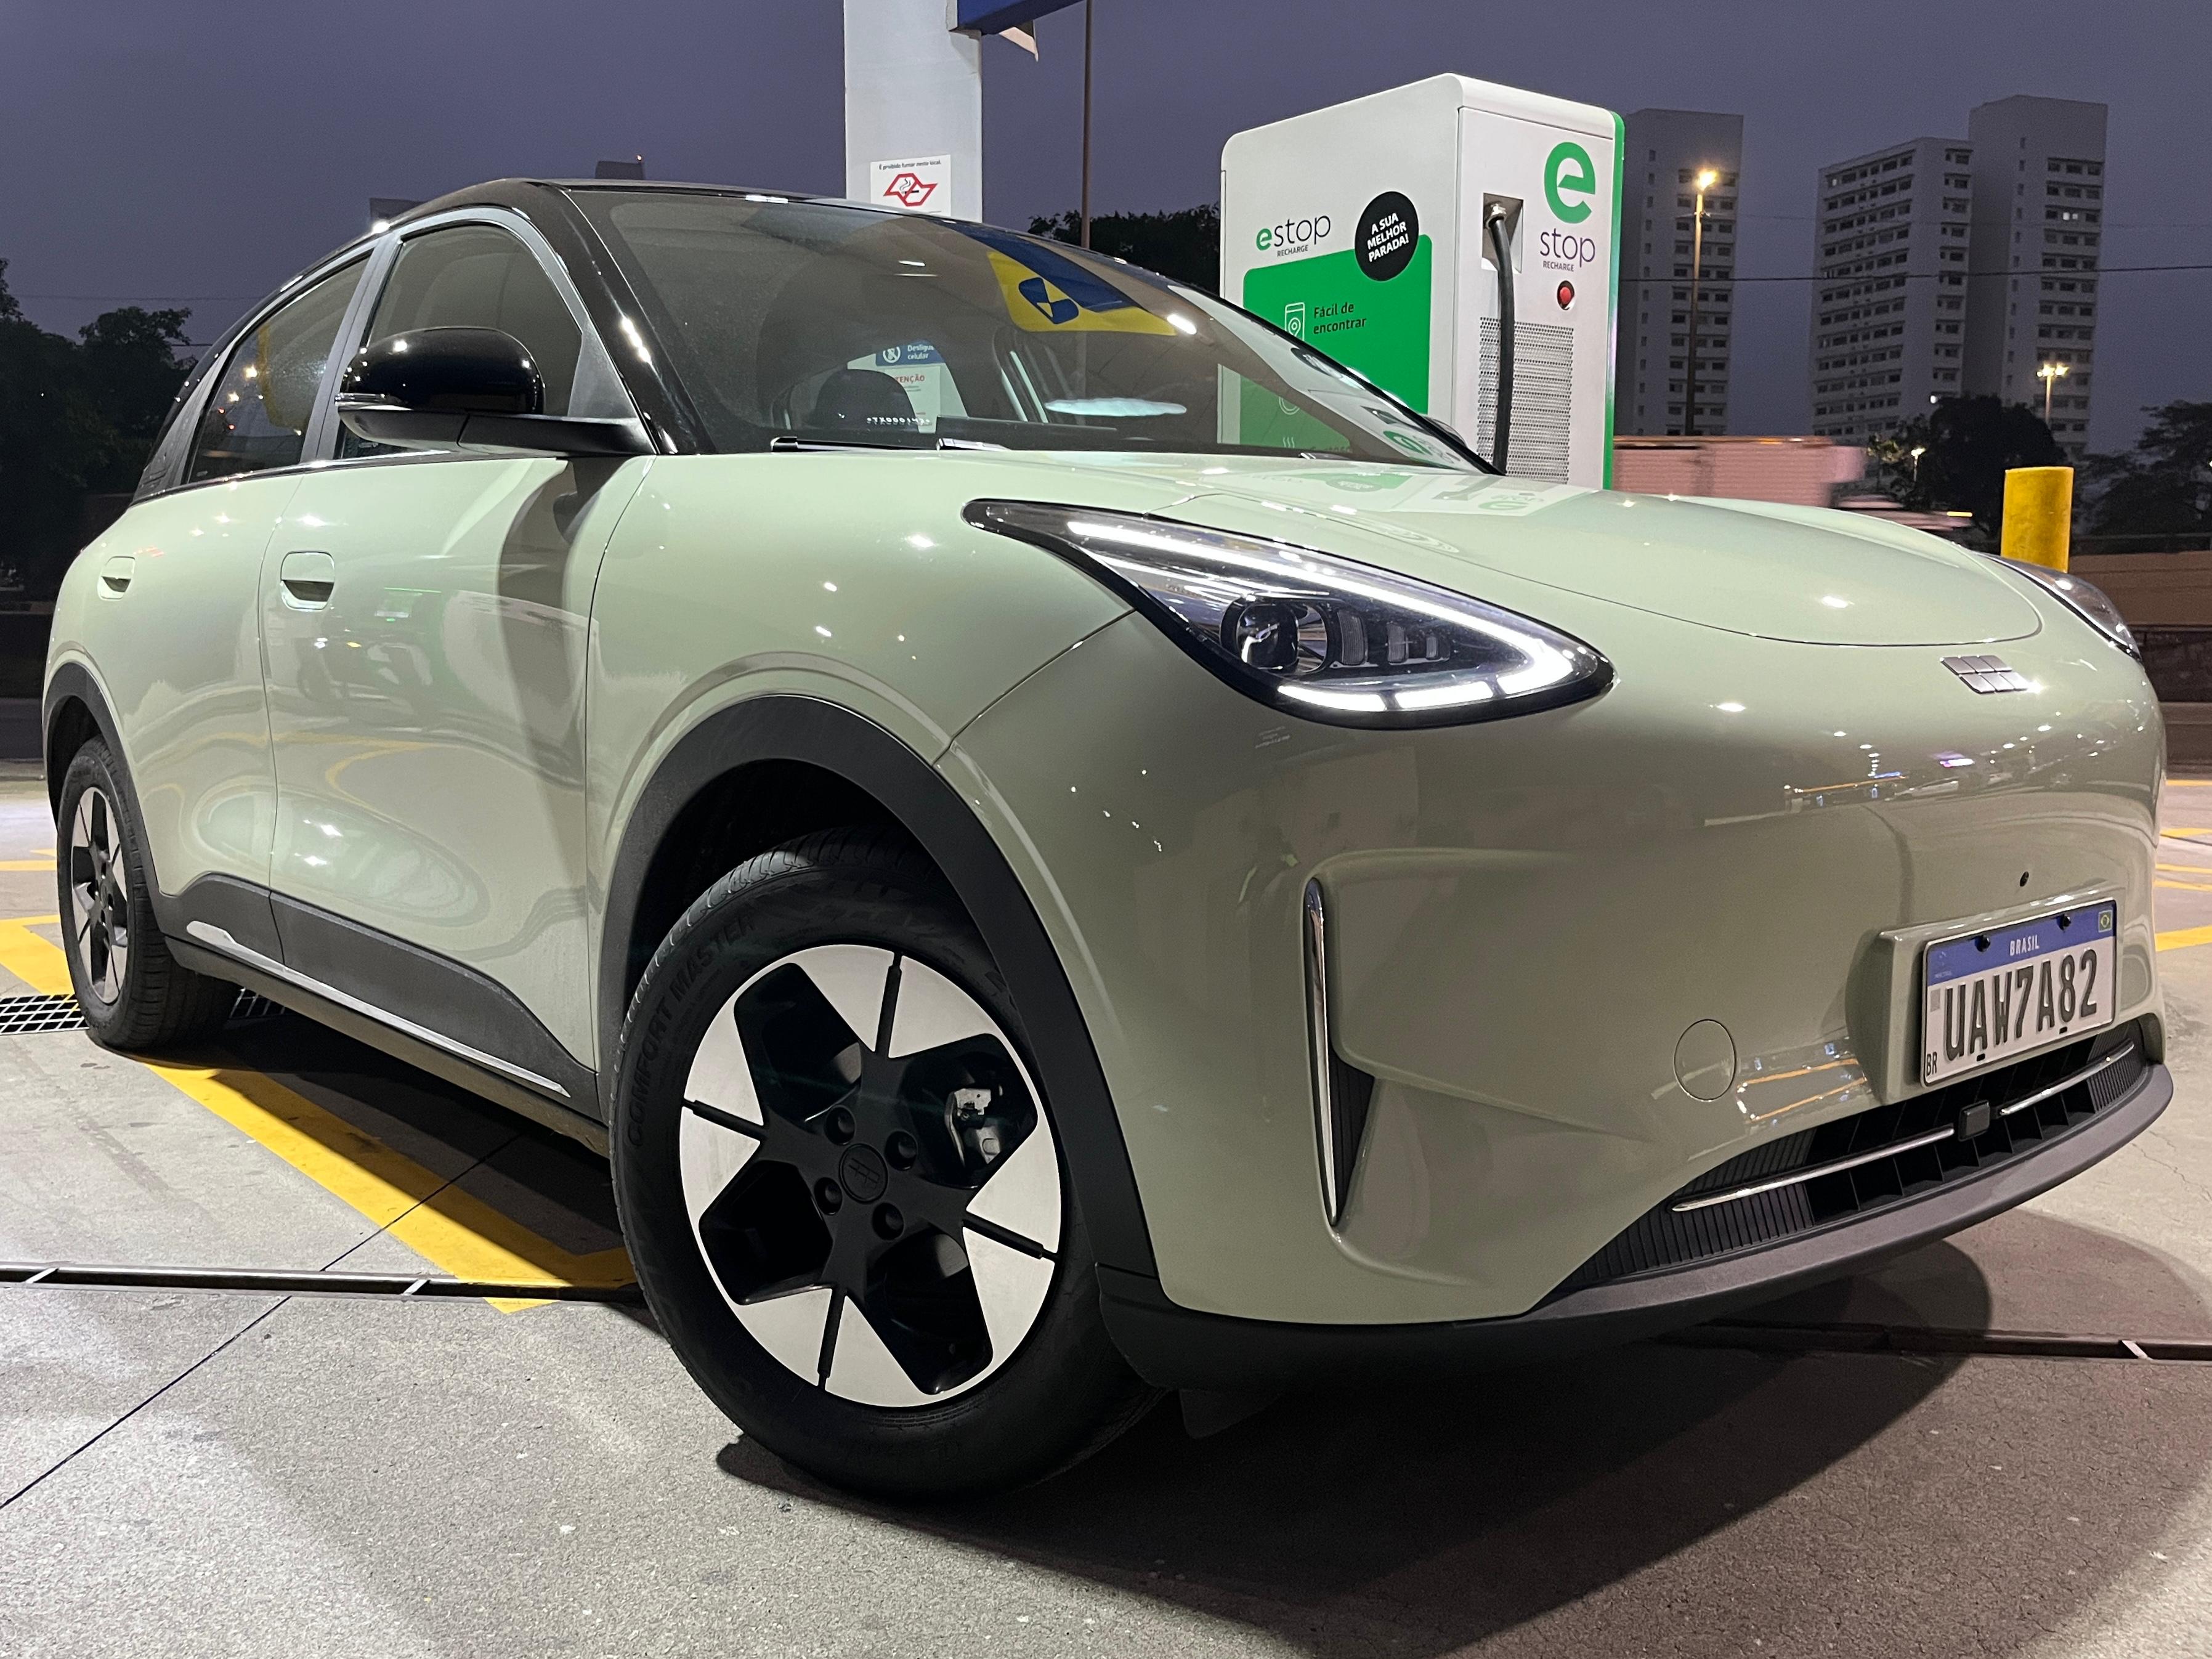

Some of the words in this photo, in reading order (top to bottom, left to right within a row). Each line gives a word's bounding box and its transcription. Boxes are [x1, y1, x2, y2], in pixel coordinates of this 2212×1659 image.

[1544, 142, 1595, 224] e
[1367, 221, 1407, 249] MELHOR
[1372, 223, 1379, 235] A
[1379, 213, 1399, 230] SUA
[1277, 245, 1308, 257] RECHARGE
[1368, 233, 1409, 262] PARADA!
[1540, 228, 1595, 267] stop
[1543, 261, 1574, 272] RECHARGE
[1314, 303, 1338, 318] Fácil
[1341, 301, 1354, 314] de
[1313, 318, 1366, 334] encontrar
[895, 373, 925, 383] TENÇÃO
[2010, 934, 2040, 956] BRASIL
[1944, 949, 2097, 1061] UAW7A82
[1926, 1051, 1937, 1076] BR
